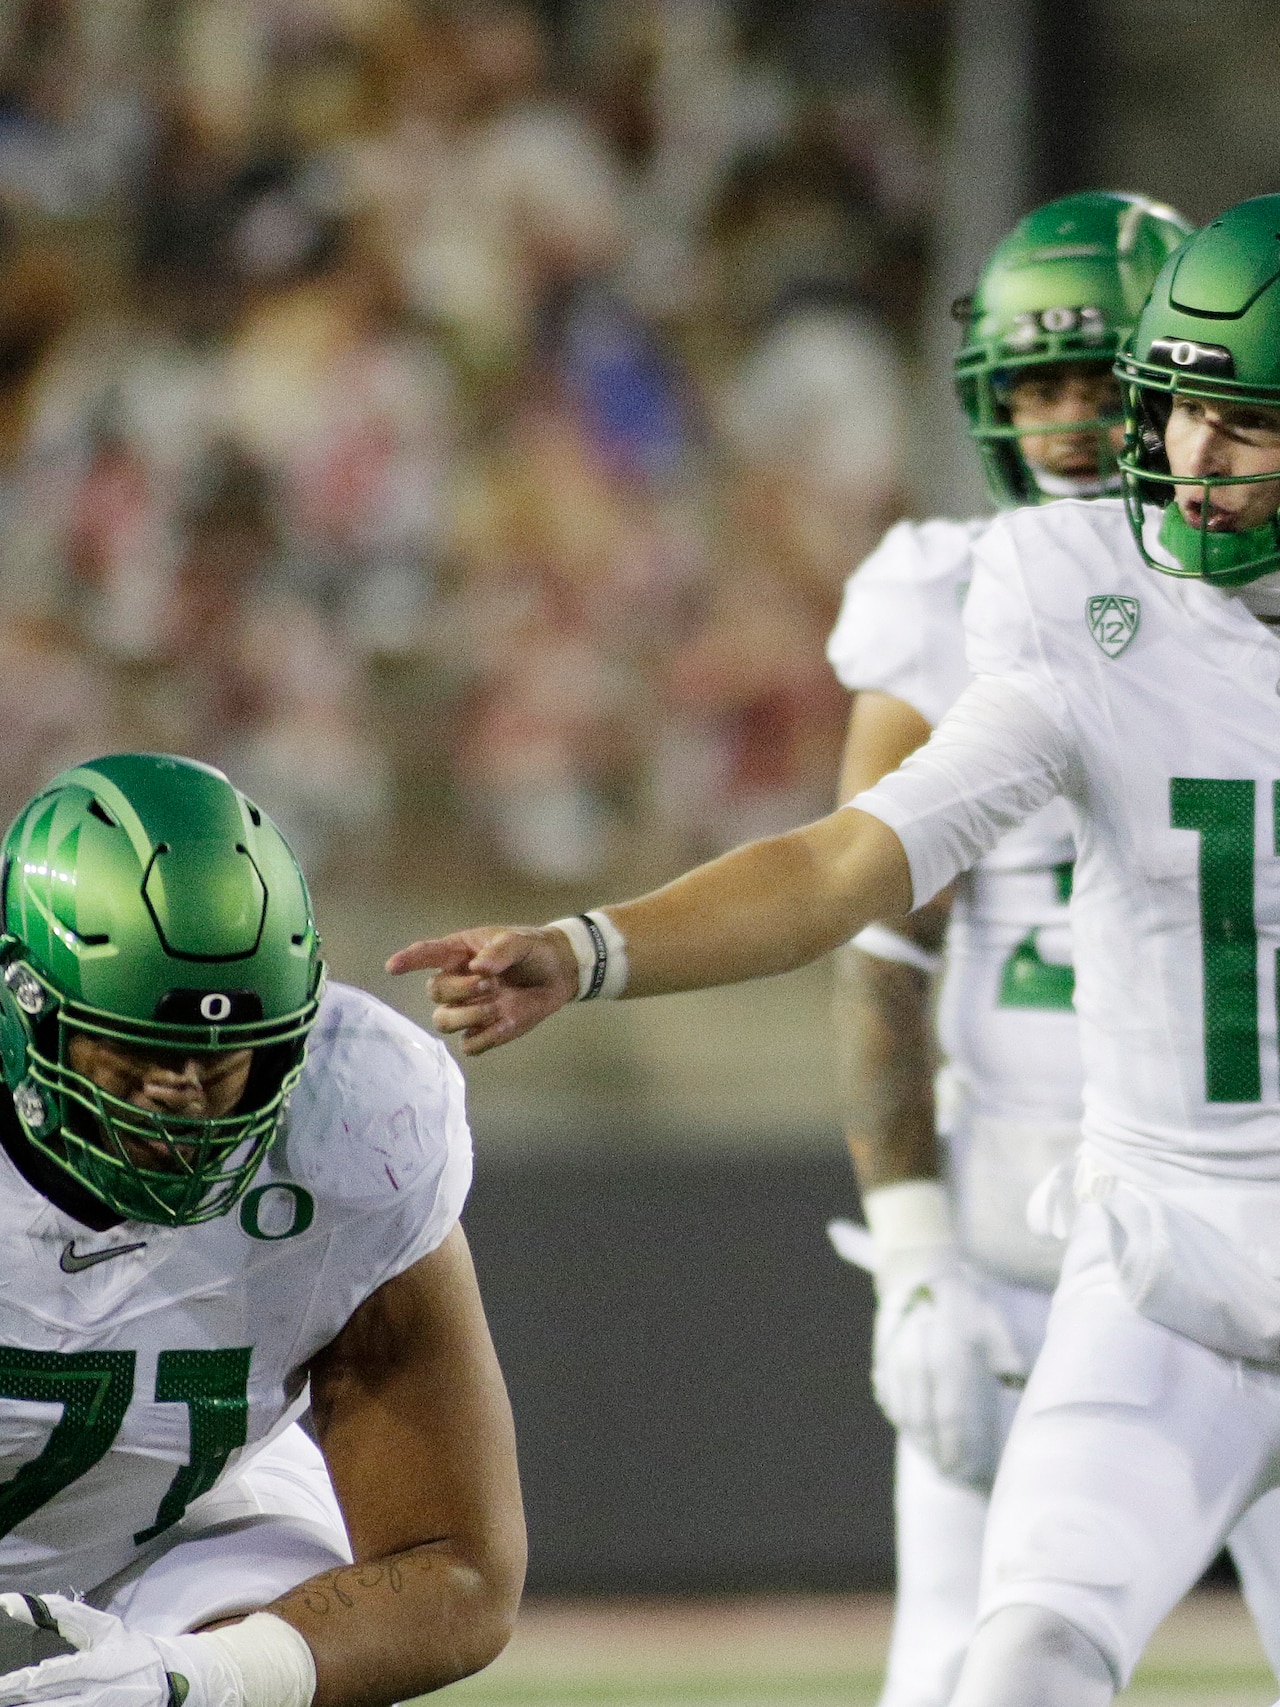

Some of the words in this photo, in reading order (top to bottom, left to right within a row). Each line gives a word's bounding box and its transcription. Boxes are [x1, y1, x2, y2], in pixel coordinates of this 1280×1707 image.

[1171, 343, 1197, 366] O
[1089, 596, 1137, 631] PAC
[1100, 621, 1125, 643] 12
[200, 993, 231, 1020] O
[240, 1183, 314, 1240] O
[0, 1346, 254, 1547] 71
